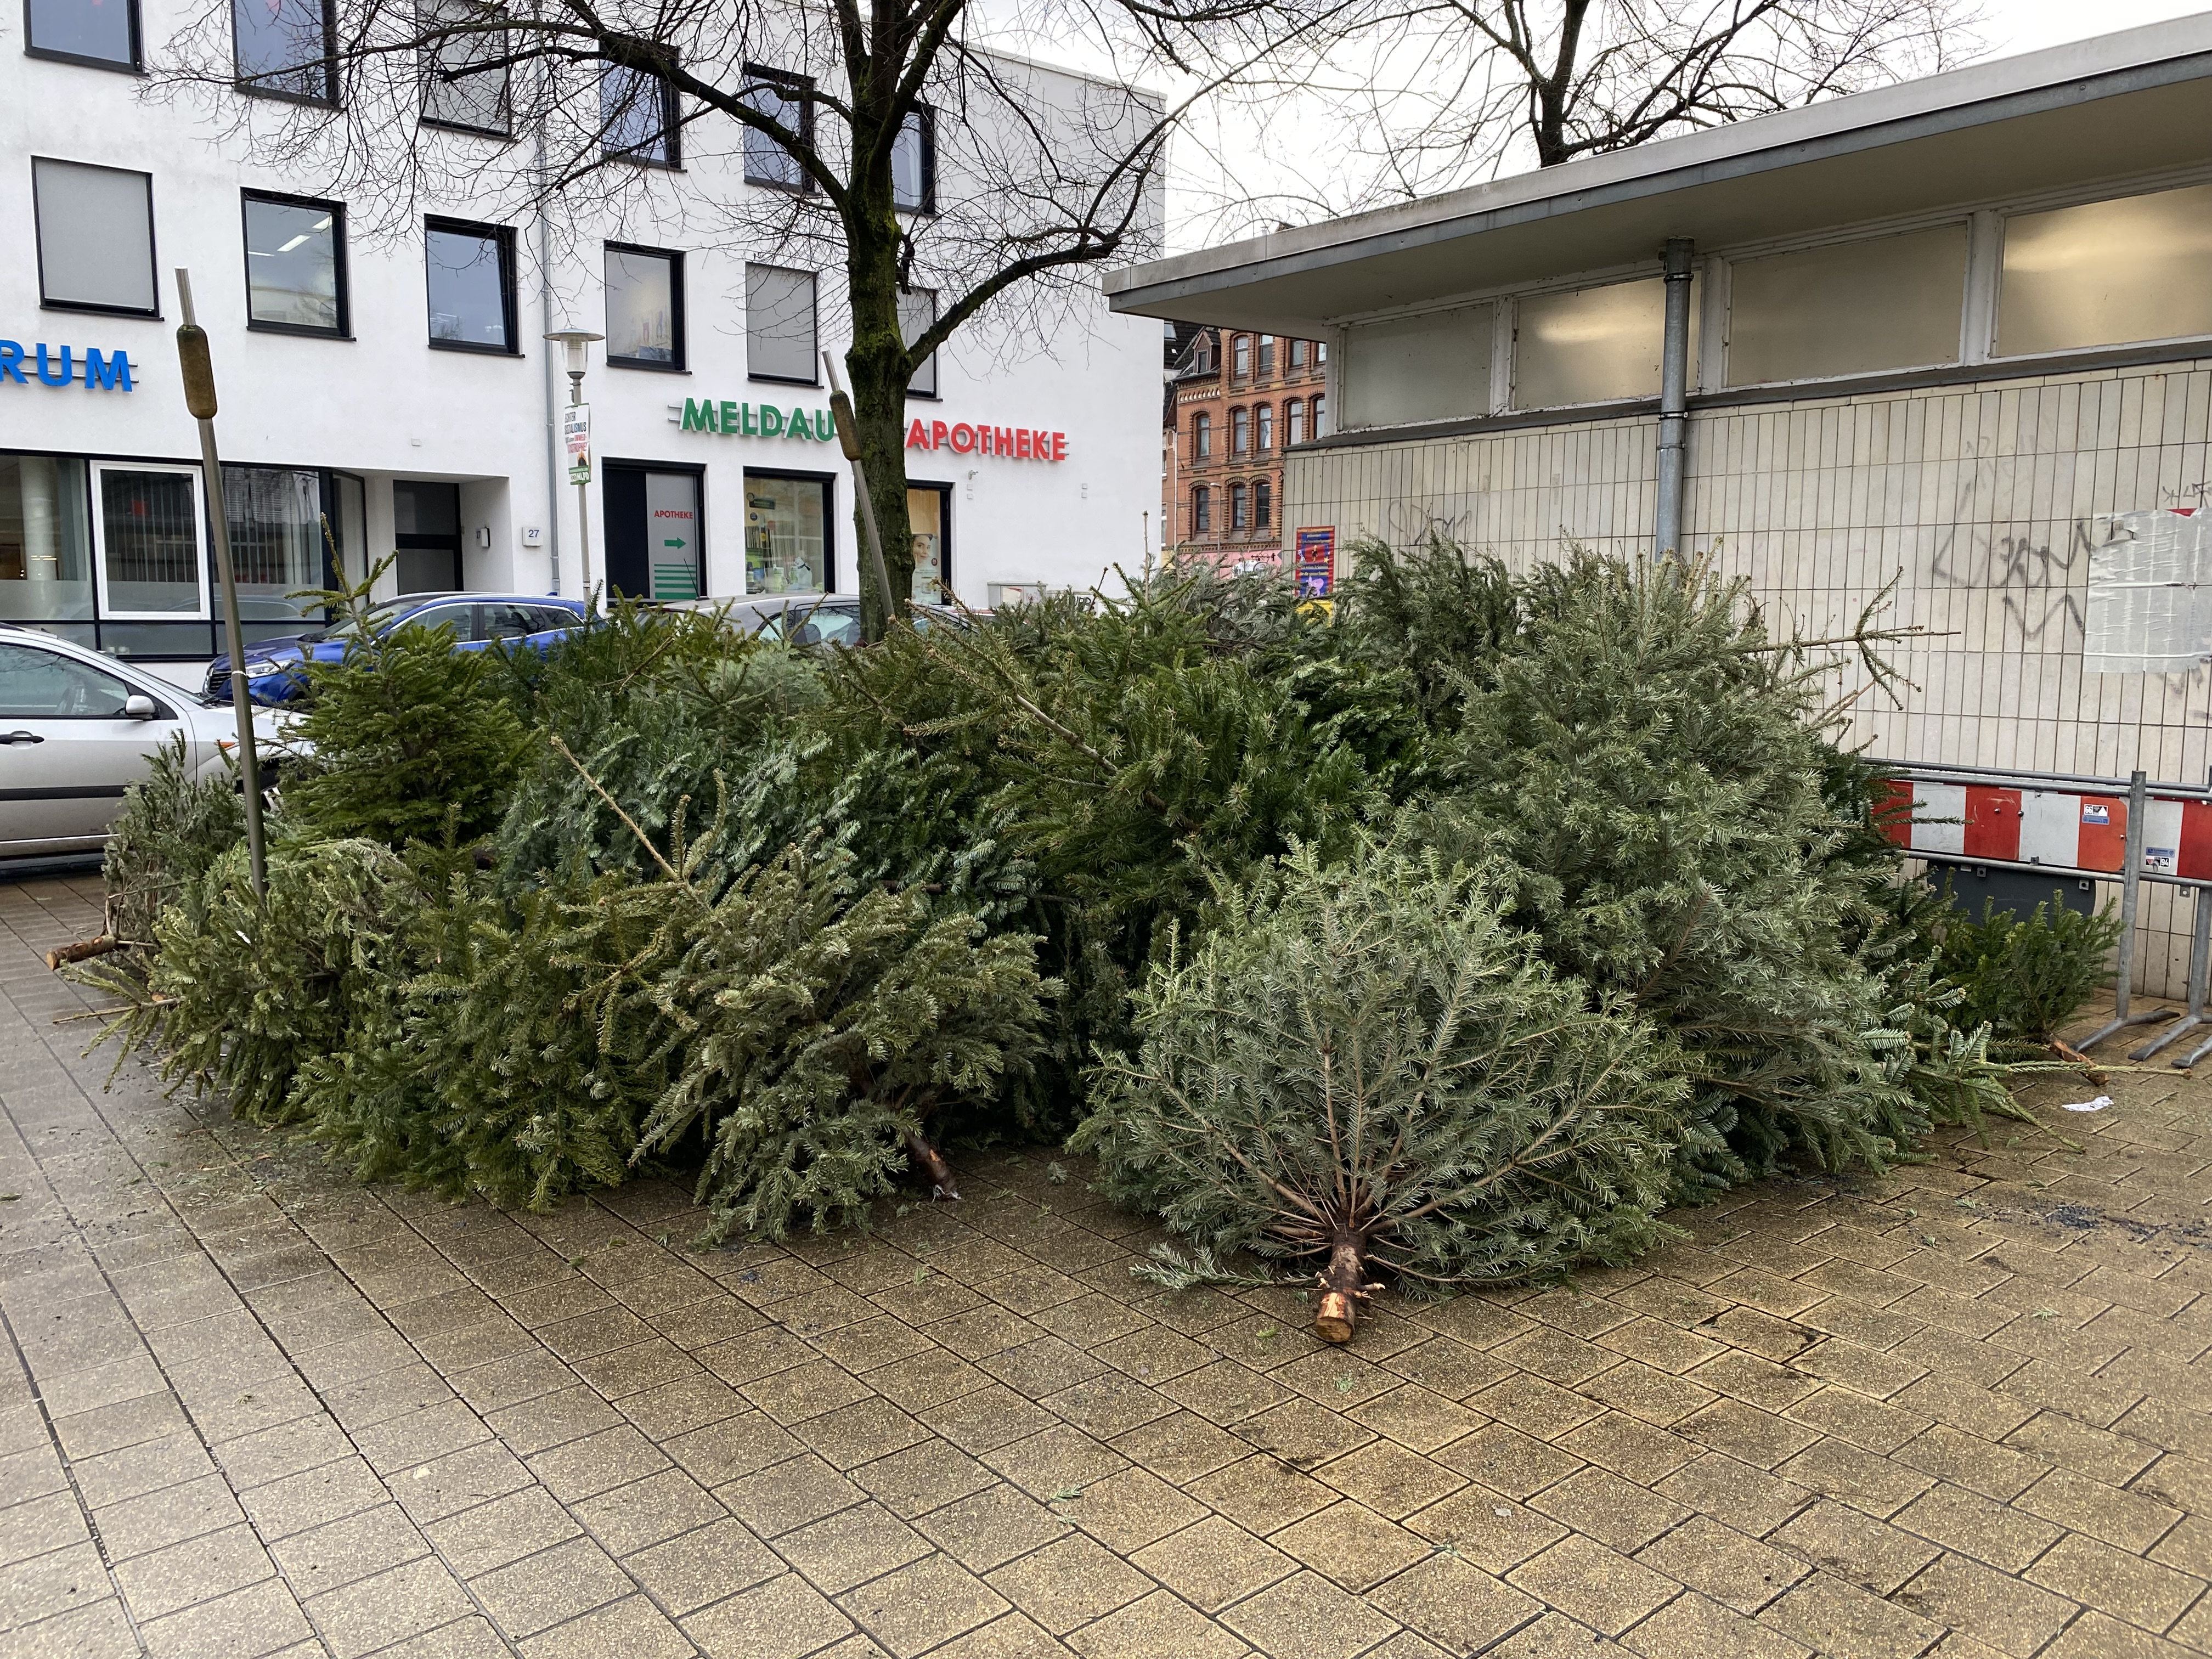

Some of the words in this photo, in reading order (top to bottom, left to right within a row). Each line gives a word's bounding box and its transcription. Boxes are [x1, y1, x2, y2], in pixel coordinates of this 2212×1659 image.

[0, 340, 132, 392] RUM
[904, 419, 1065, 460] APOTHEKE
[654, 510, 693, 519] APOTHEKE
[528, 529, 539, 538] 27
